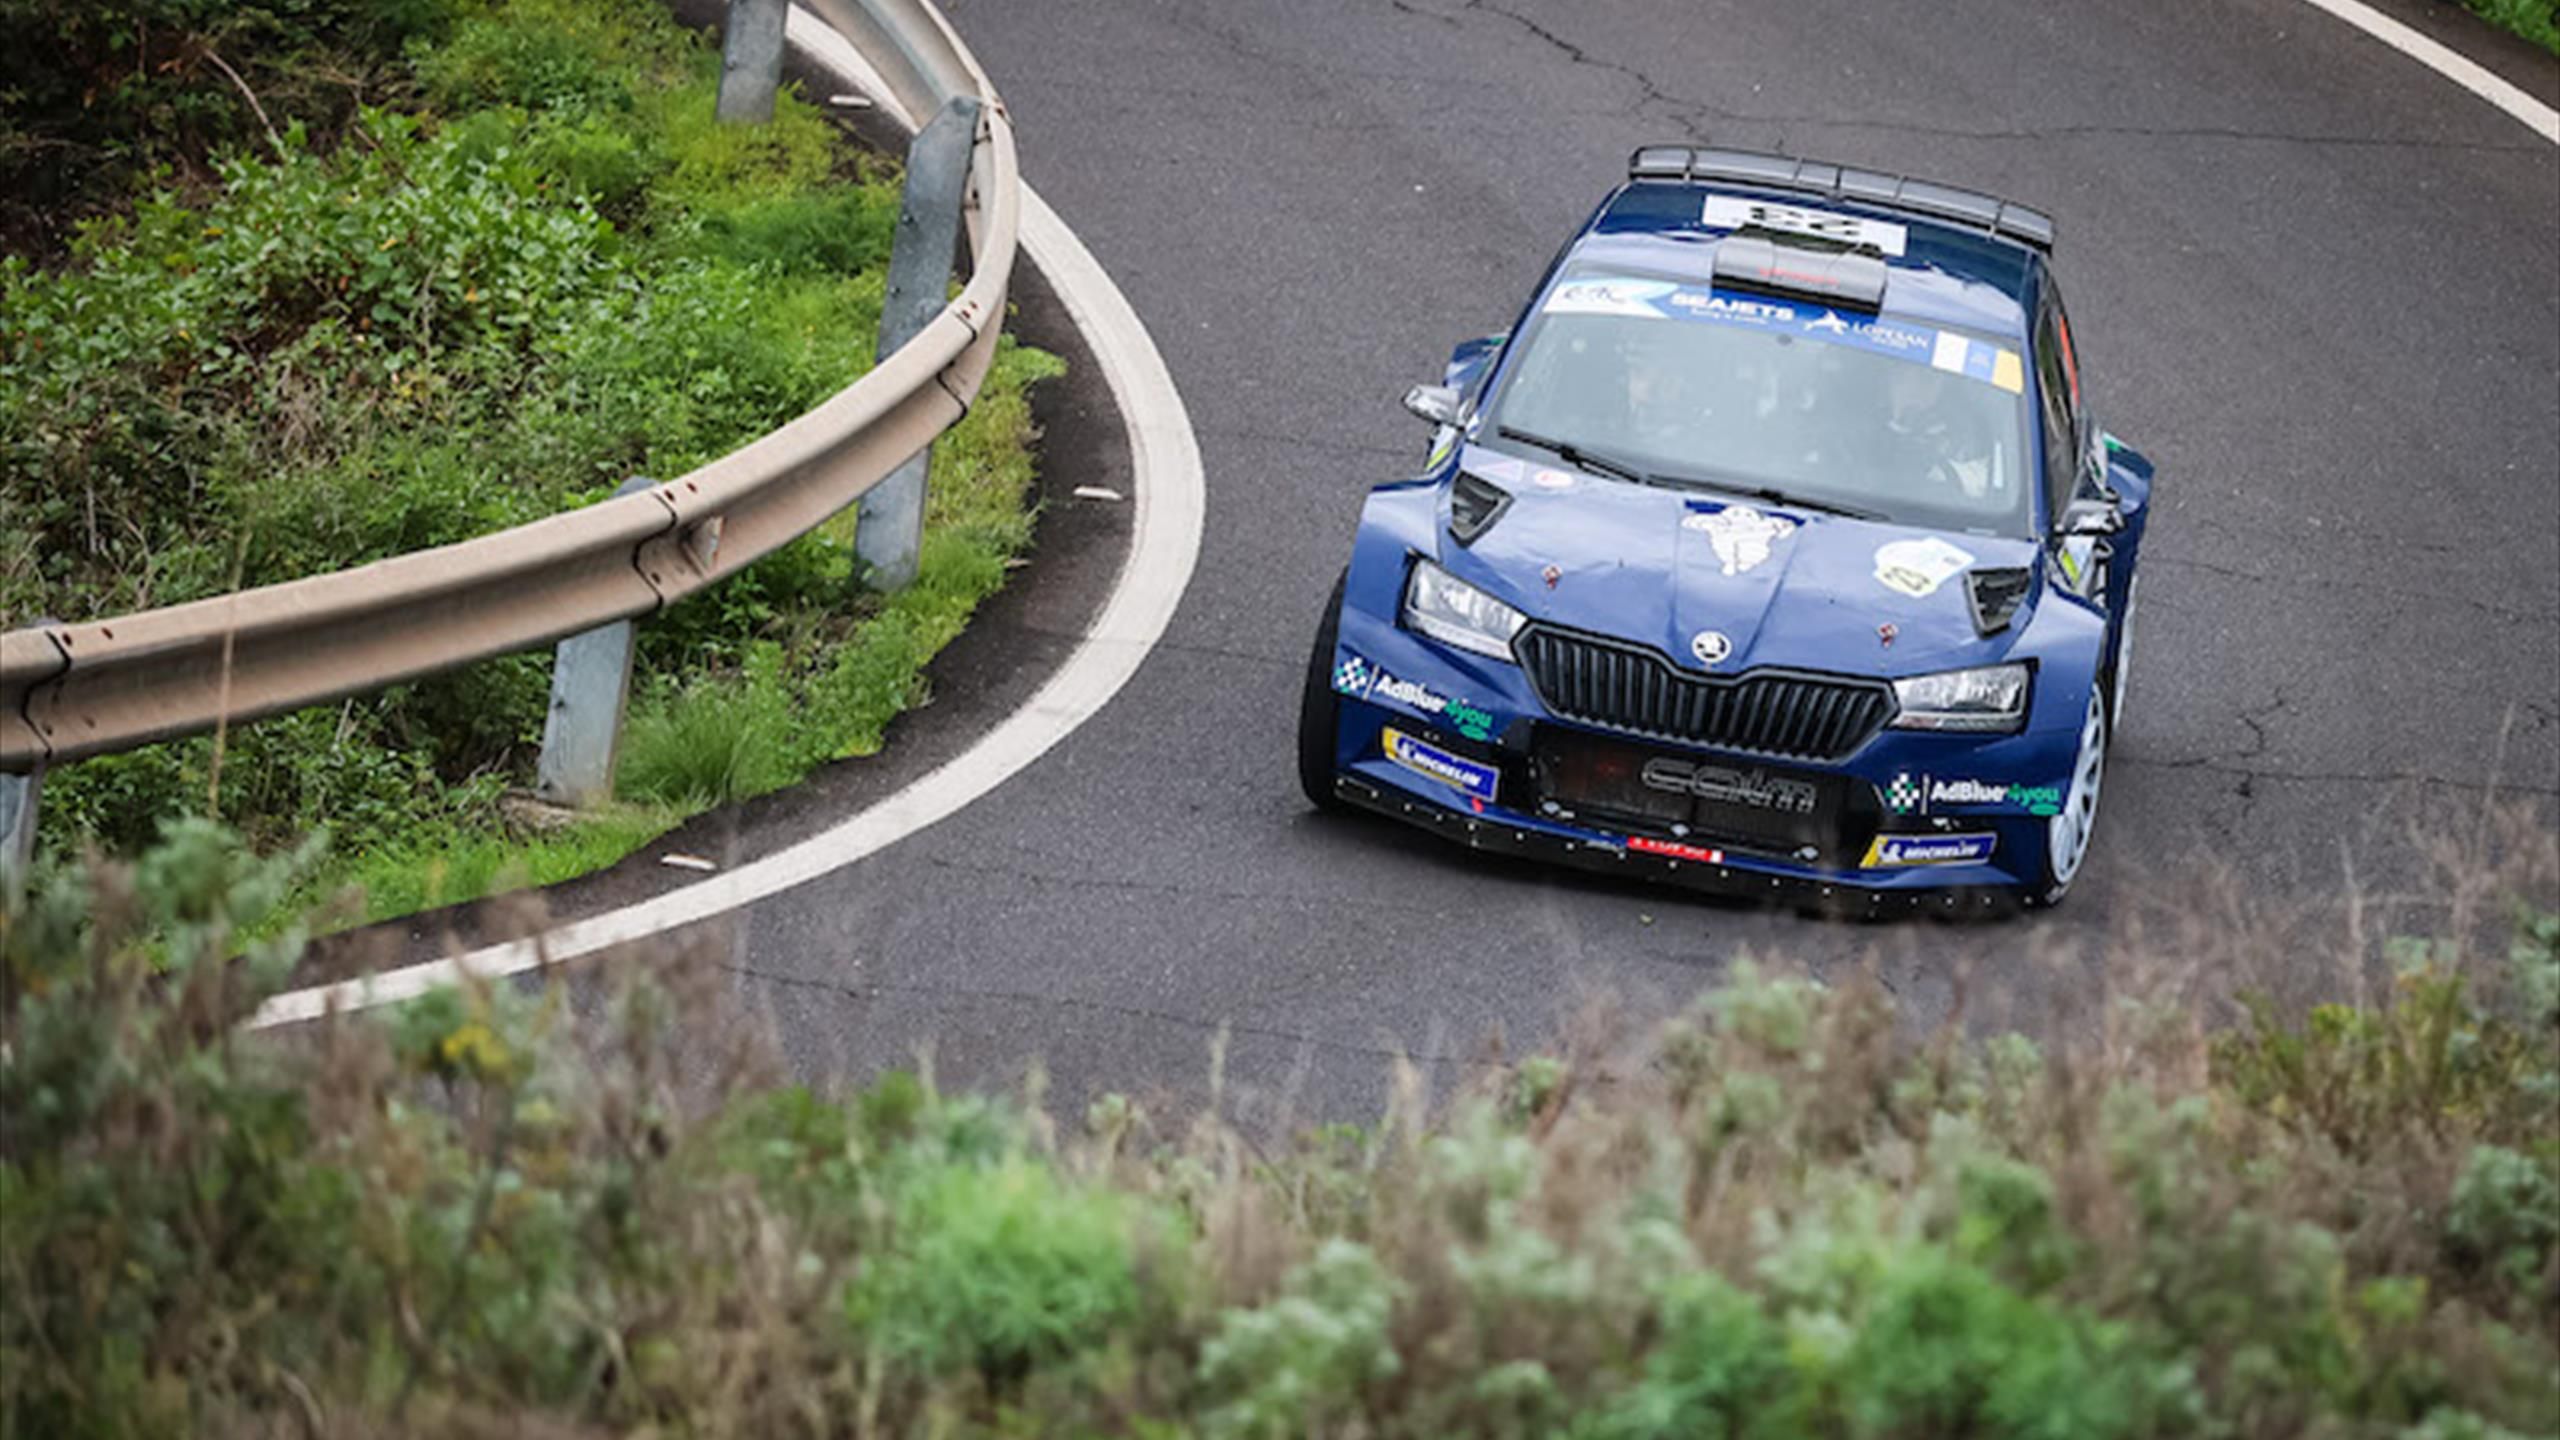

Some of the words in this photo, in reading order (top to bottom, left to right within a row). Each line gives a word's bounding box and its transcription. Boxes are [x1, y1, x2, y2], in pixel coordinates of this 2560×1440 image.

[1671, 292, 1796, 321] SEAJETS
[1853, 321, 1929, 350] LOPESAN
[1413, 751, 1482, 787] MICHELIN
[1904, 843, 1981, 861] MICHELIN
